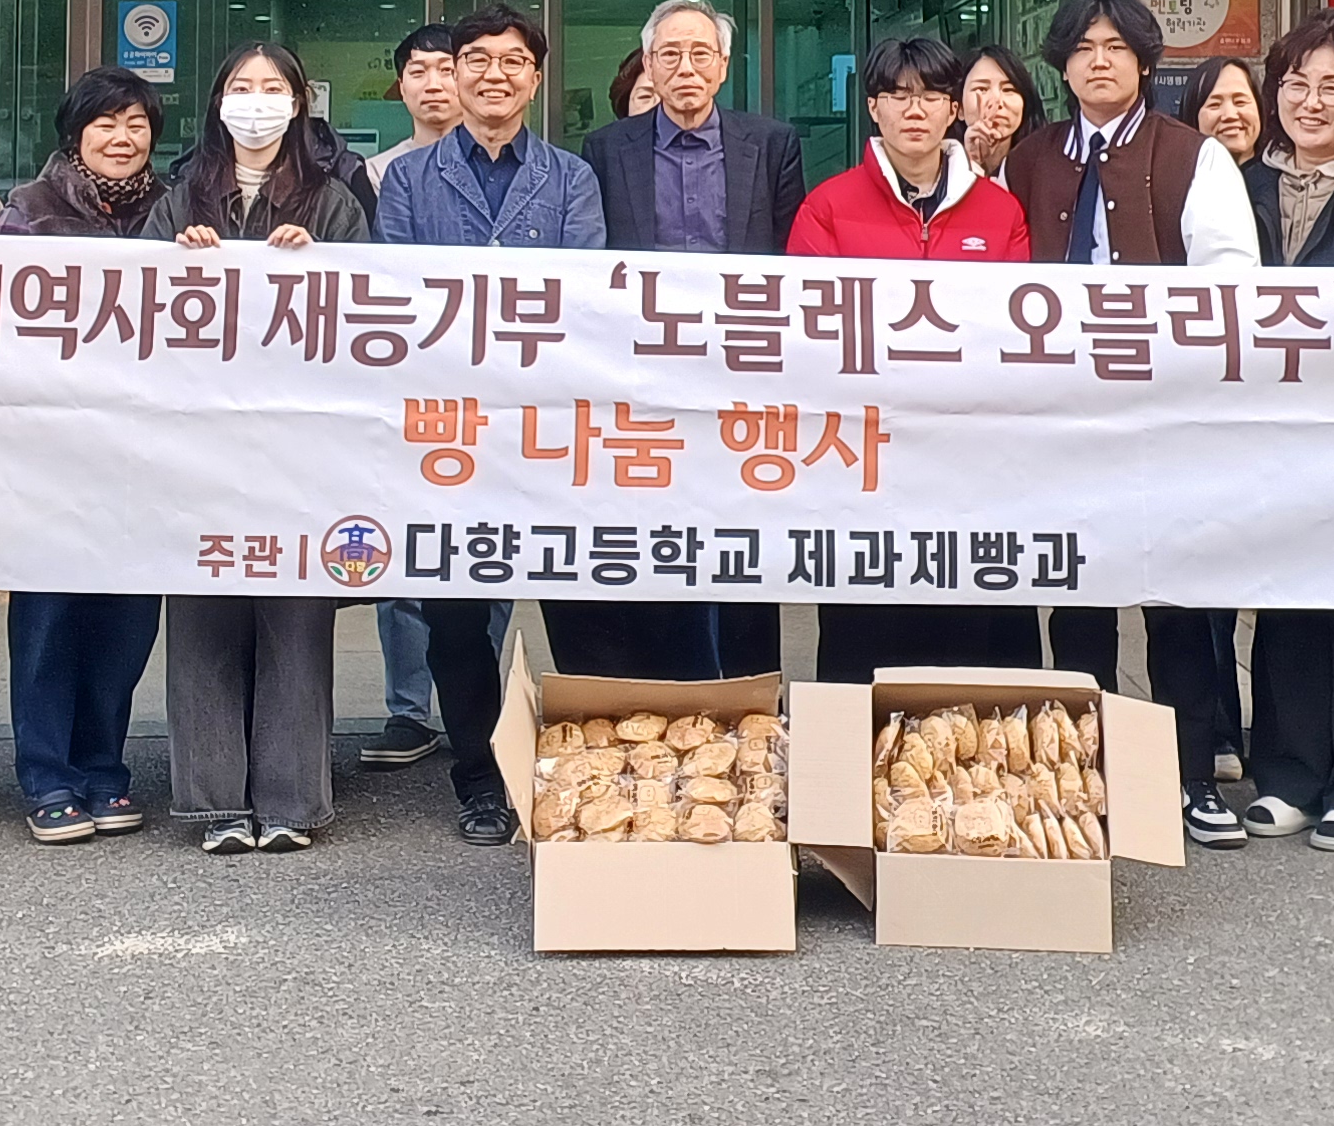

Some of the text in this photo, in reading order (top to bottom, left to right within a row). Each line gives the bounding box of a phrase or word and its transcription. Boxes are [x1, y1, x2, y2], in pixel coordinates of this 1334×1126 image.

[262, 270, 567, 368] 재능기부
[402, 396, 892, 494] 빵 나눔 행사
[197, 522, 1087, 593] 주관 다향고등학교 제과제빵과
